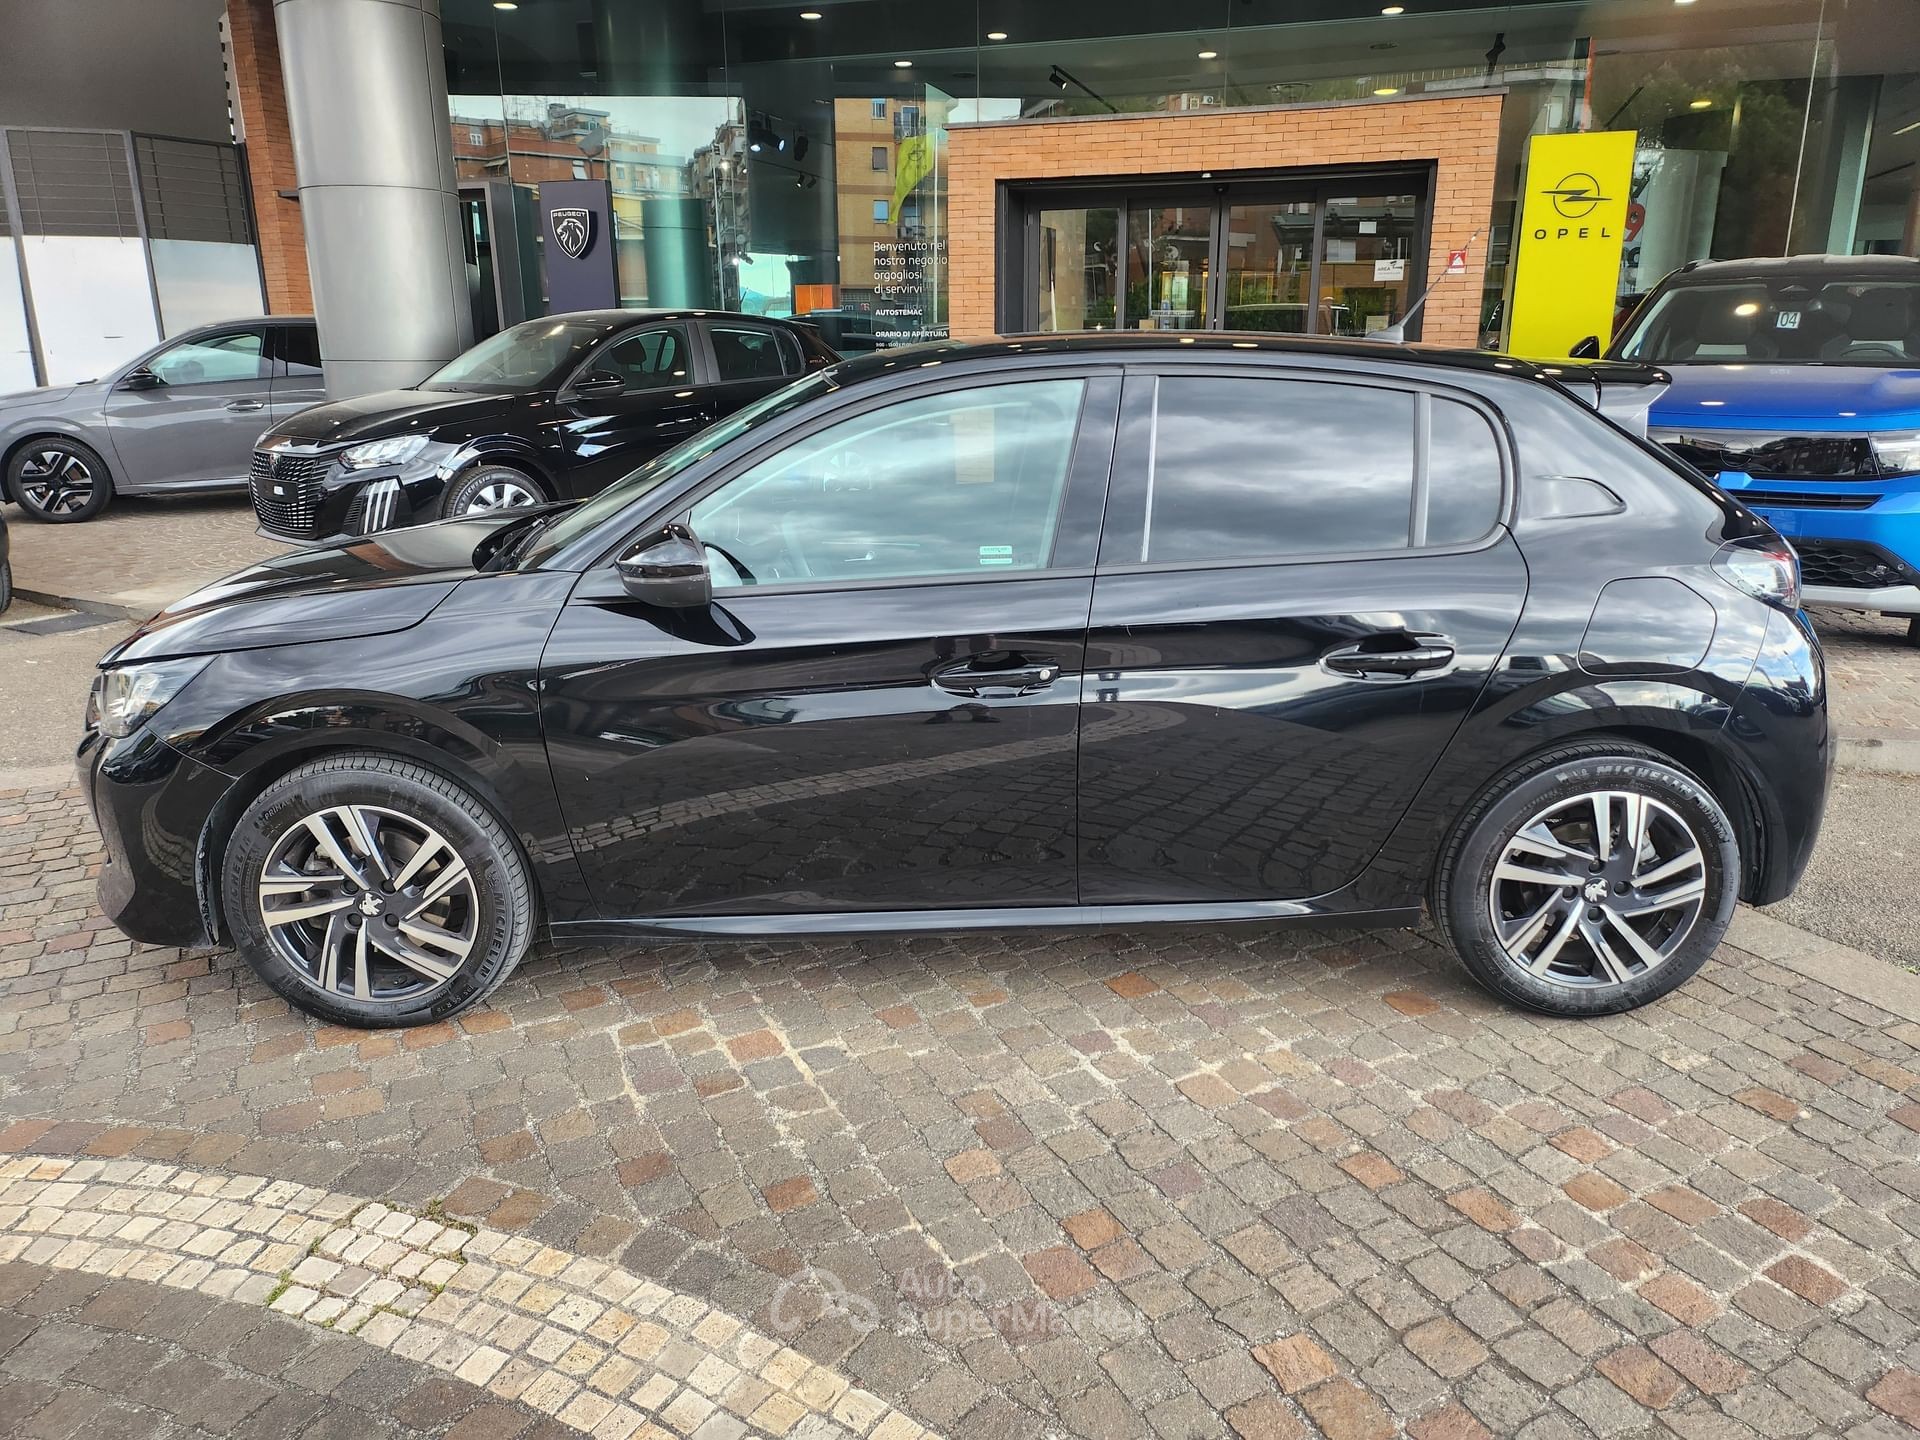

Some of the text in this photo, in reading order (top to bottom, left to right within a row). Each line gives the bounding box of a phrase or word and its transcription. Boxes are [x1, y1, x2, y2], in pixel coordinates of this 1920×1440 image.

[1534, 228, 1611, 240] OPEL
[873, 240, 946, 252] Benvenuto nel
[873, 255, 948, 268] nostro negozio
[873, 269, 923, 282] orgogliosi
[874, 283, 923, 294] di servirvi
[1780, 312, 1798, 327] 04
[1596, 765, 1692, 796] MICHELIN
[480, 892, 505, 978] MICHELIN
